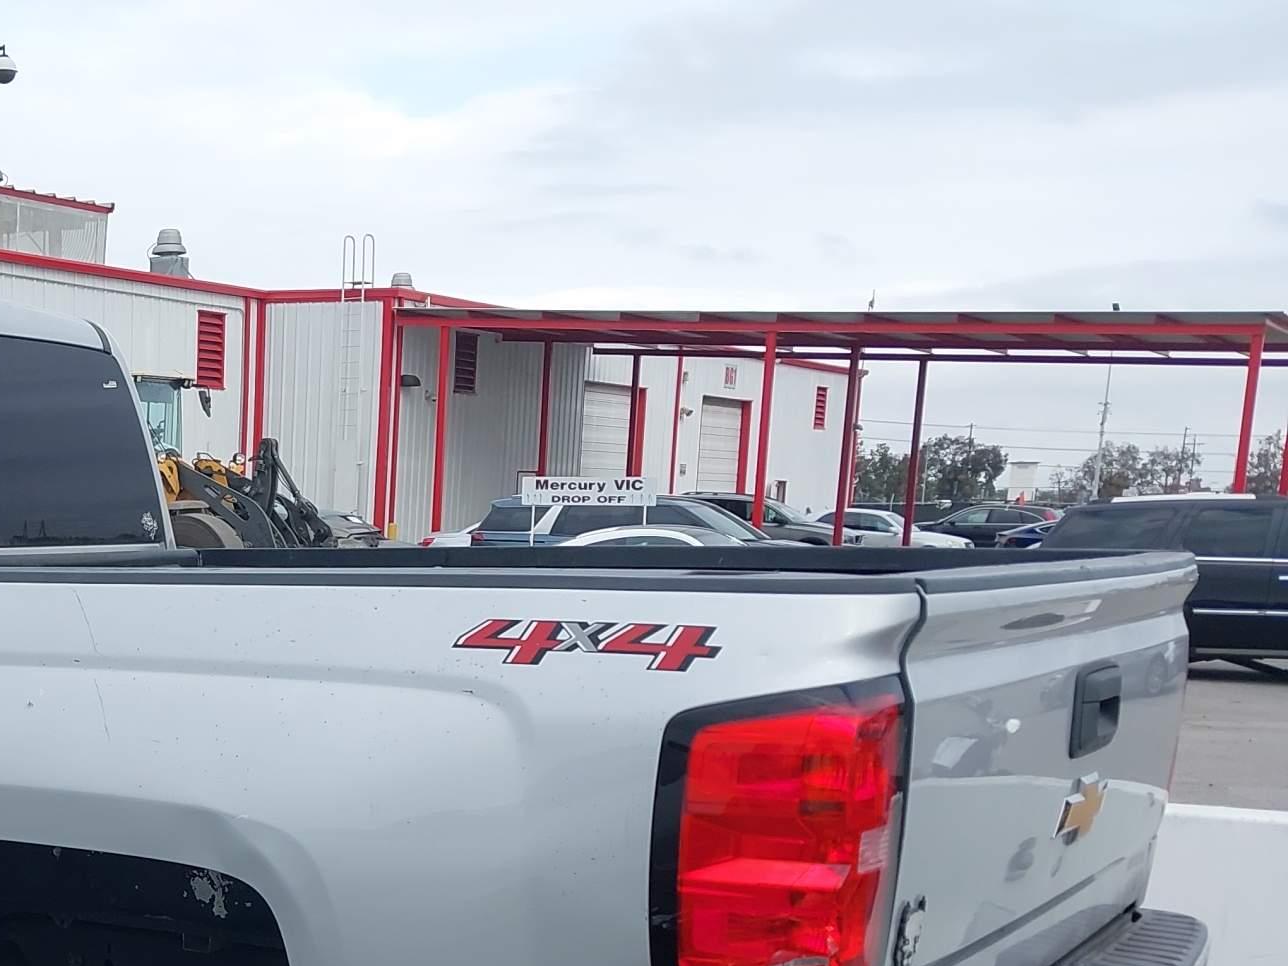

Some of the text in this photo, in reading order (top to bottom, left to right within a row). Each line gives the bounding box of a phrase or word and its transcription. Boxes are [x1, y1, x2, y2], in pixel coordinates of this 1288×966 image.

[535, 479, 644, 492] Mercury VIC
[551, 495, 627, 503] DROP OFF
